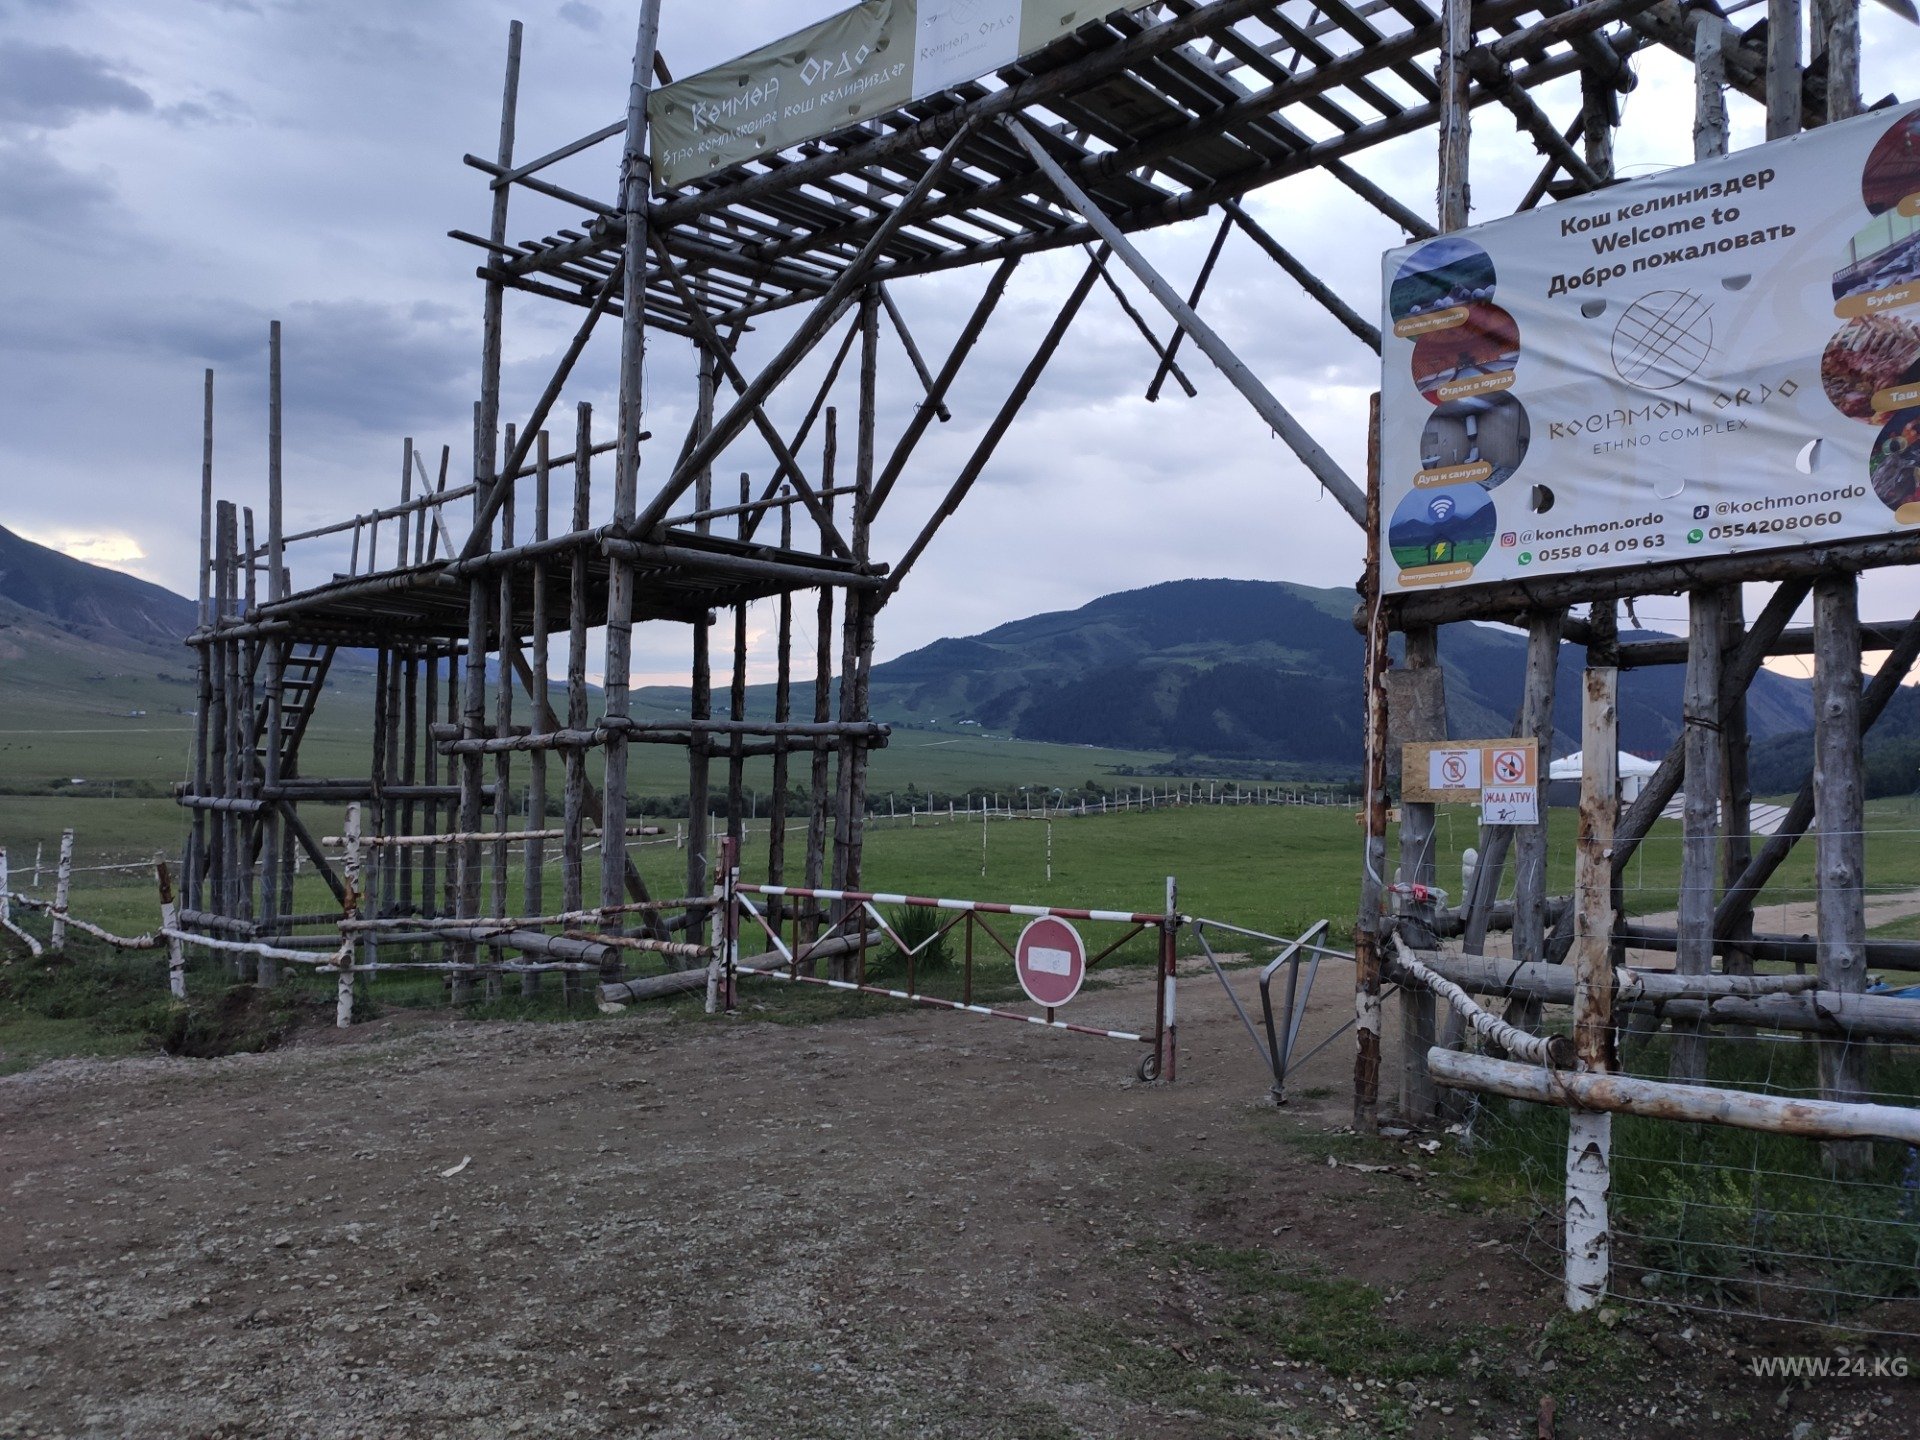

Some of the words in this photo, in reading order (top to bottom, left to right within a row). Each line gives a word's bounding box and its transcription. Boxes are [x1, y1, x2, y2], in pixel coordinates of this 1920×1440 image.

[800, 44, 869, 86] Ордо
[1560, 212, 1611, 237] Кош
[1617, 168, 1775, 222] келиниздер
[1592, 216, 1706, 254] Welcome
[1712, 207, 1740, 225] to
[1548, 263, 1626, 298] Добро
[1633, 223, 1796, 272] пожаловать
[1867, 290, 1910, 307] Буфет
[1440, 384, 1472, 396] Отдых
[1481, 375, 1513, 389] юртах
[1593, 434, 1651, 455] ETHNO
[1658, 418, 1749, 443] COMPLEX
[1418, 474, 1439, 485] Душ
[1449, 466, 1488, 479] санузел
[1715, 485, 1866, 515] @kochmonordo
[1520, 512, 1664, 545] @konchmon.ordo
[1708, 511, 1842, 539] 0554208060
[1539, 545, 1582, 562] 0558
[1586, 543, 1610, 556] 04
[1615, 538, 1638, 551] 09
[1643, 534, 1665, 548] 63
[1485, 792, 1506, 803] ЖАА
[1509, 792, 1530, 803] АТУУ
